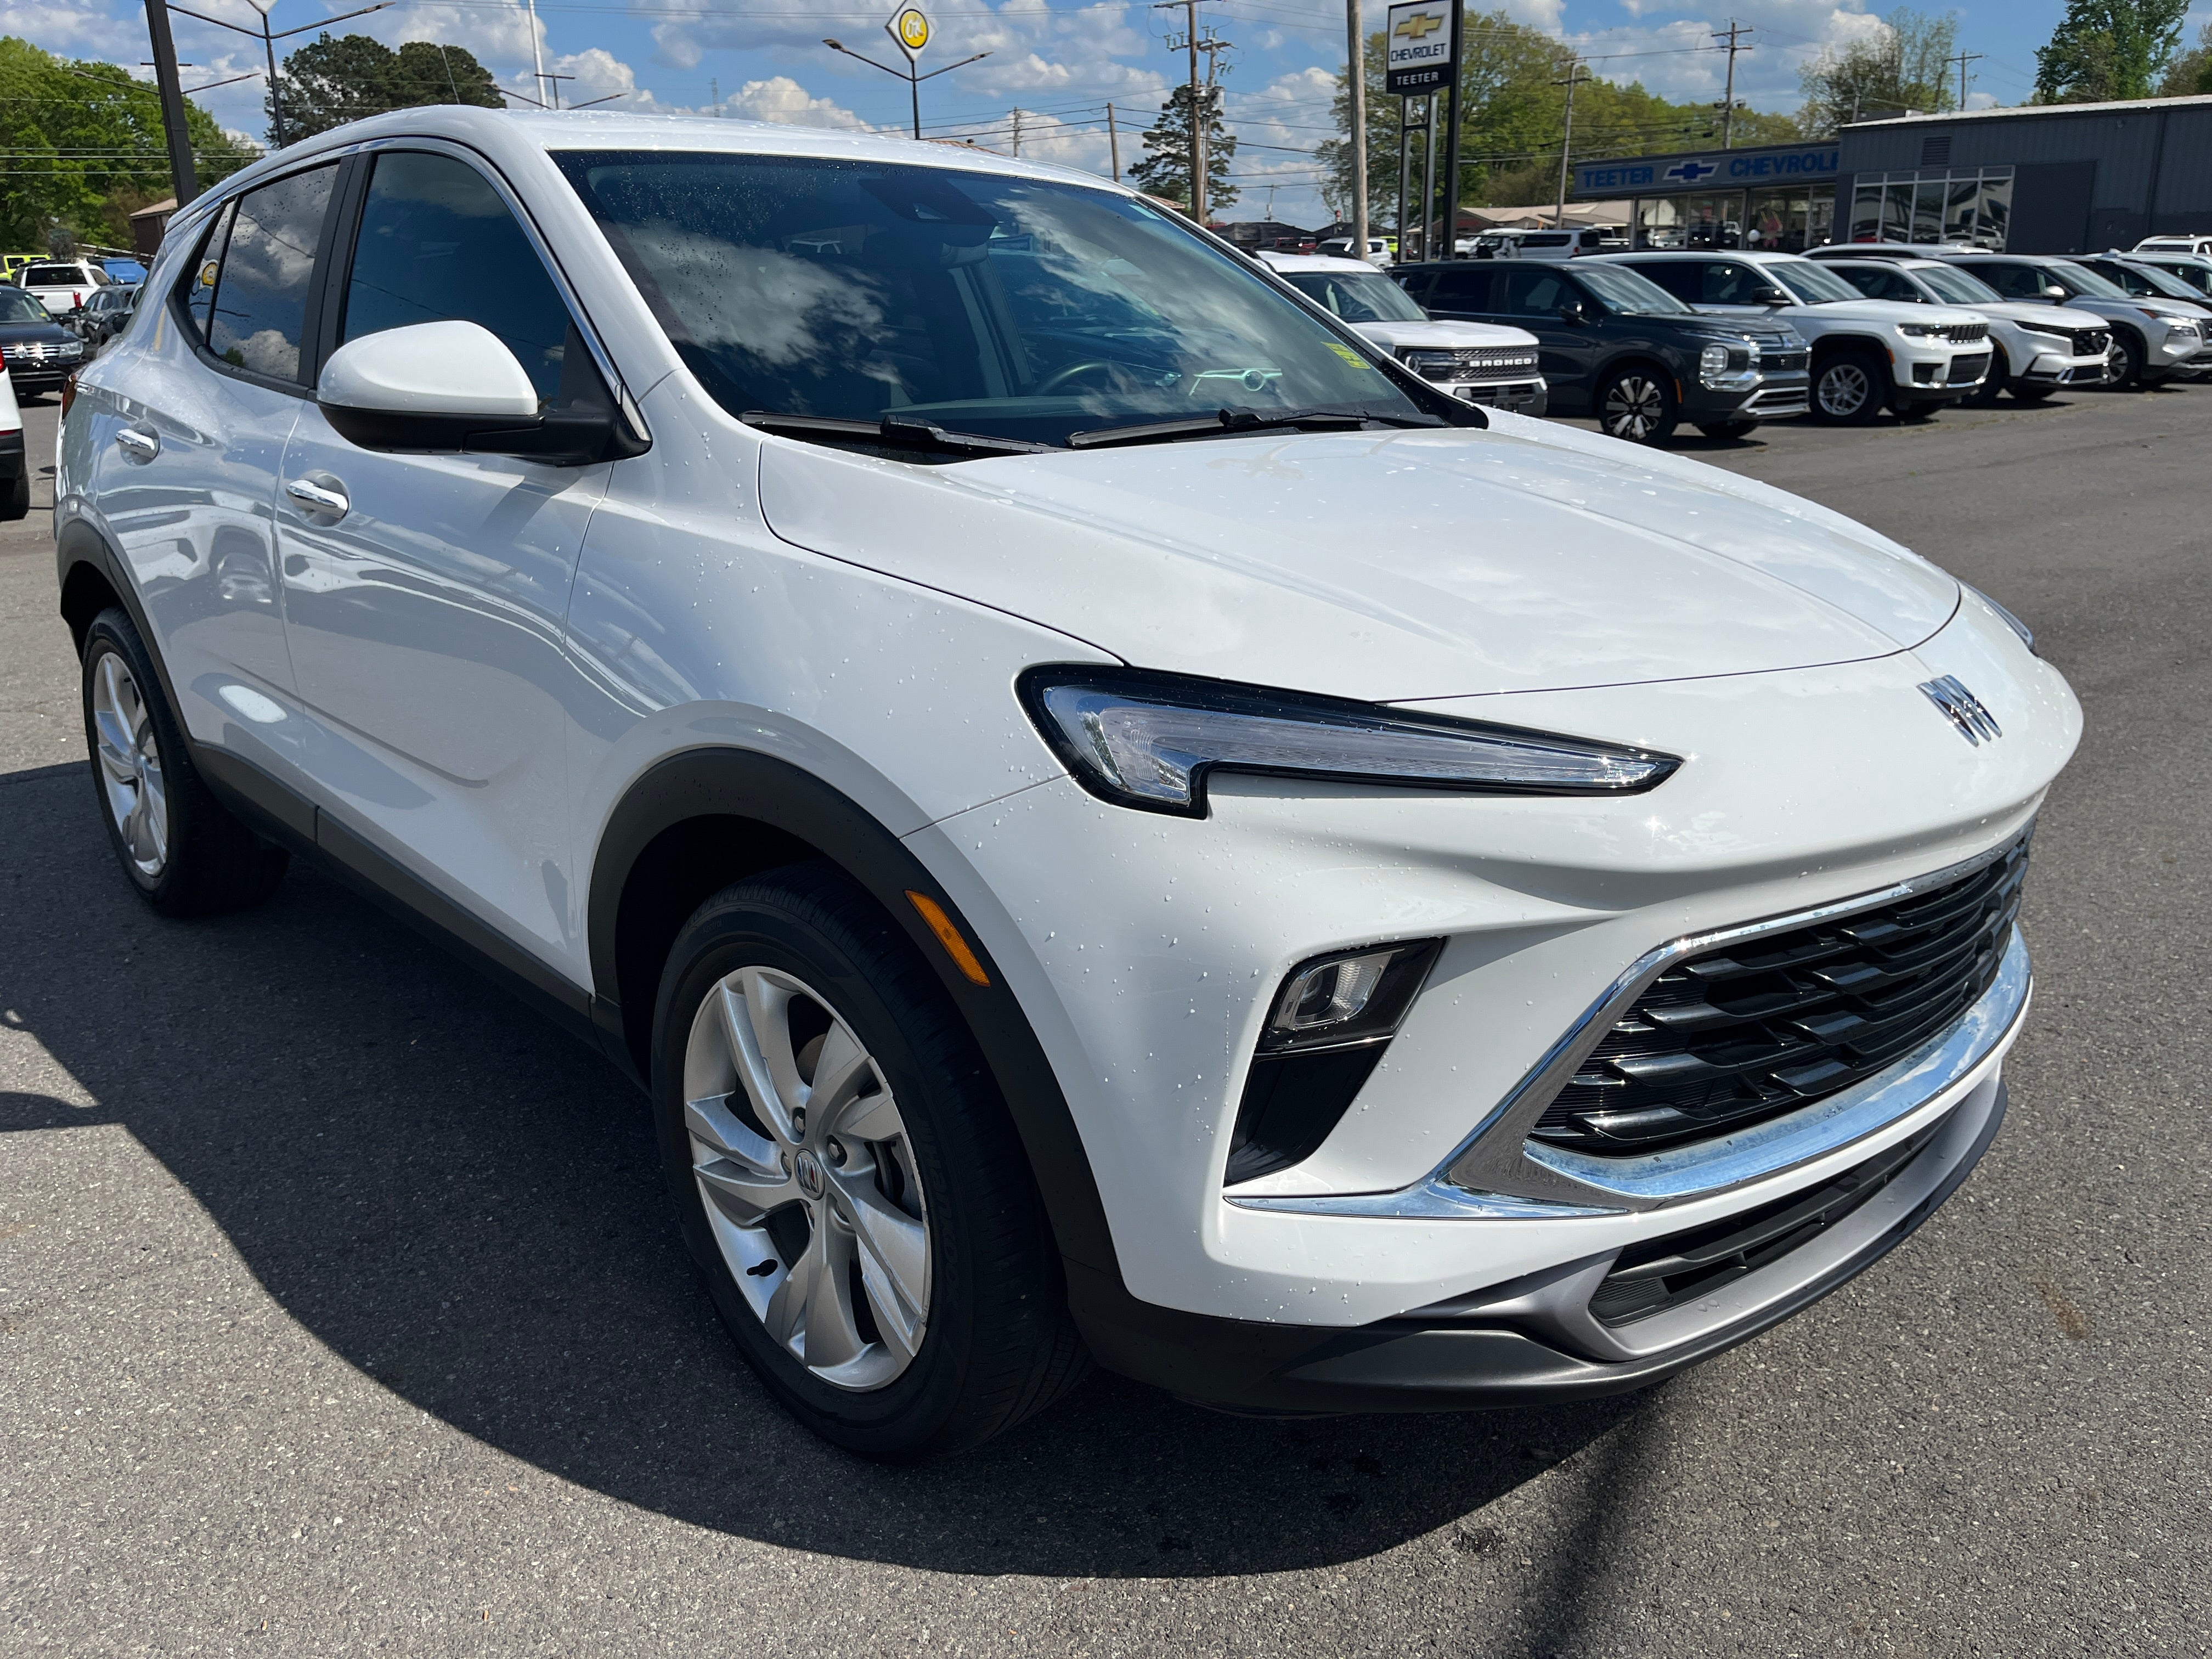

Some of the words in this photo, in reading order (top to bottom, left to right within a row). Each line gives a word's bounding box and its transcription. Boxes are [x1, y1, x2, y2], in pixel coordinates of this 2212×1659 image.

[1390, 43, 1446, 62] CHEVROLET
[1396, 71, 1439, 86] TEETER
[1583, 166, 1654, 188] TEETER
[1469, 357, 1532, 367] BRONCO
